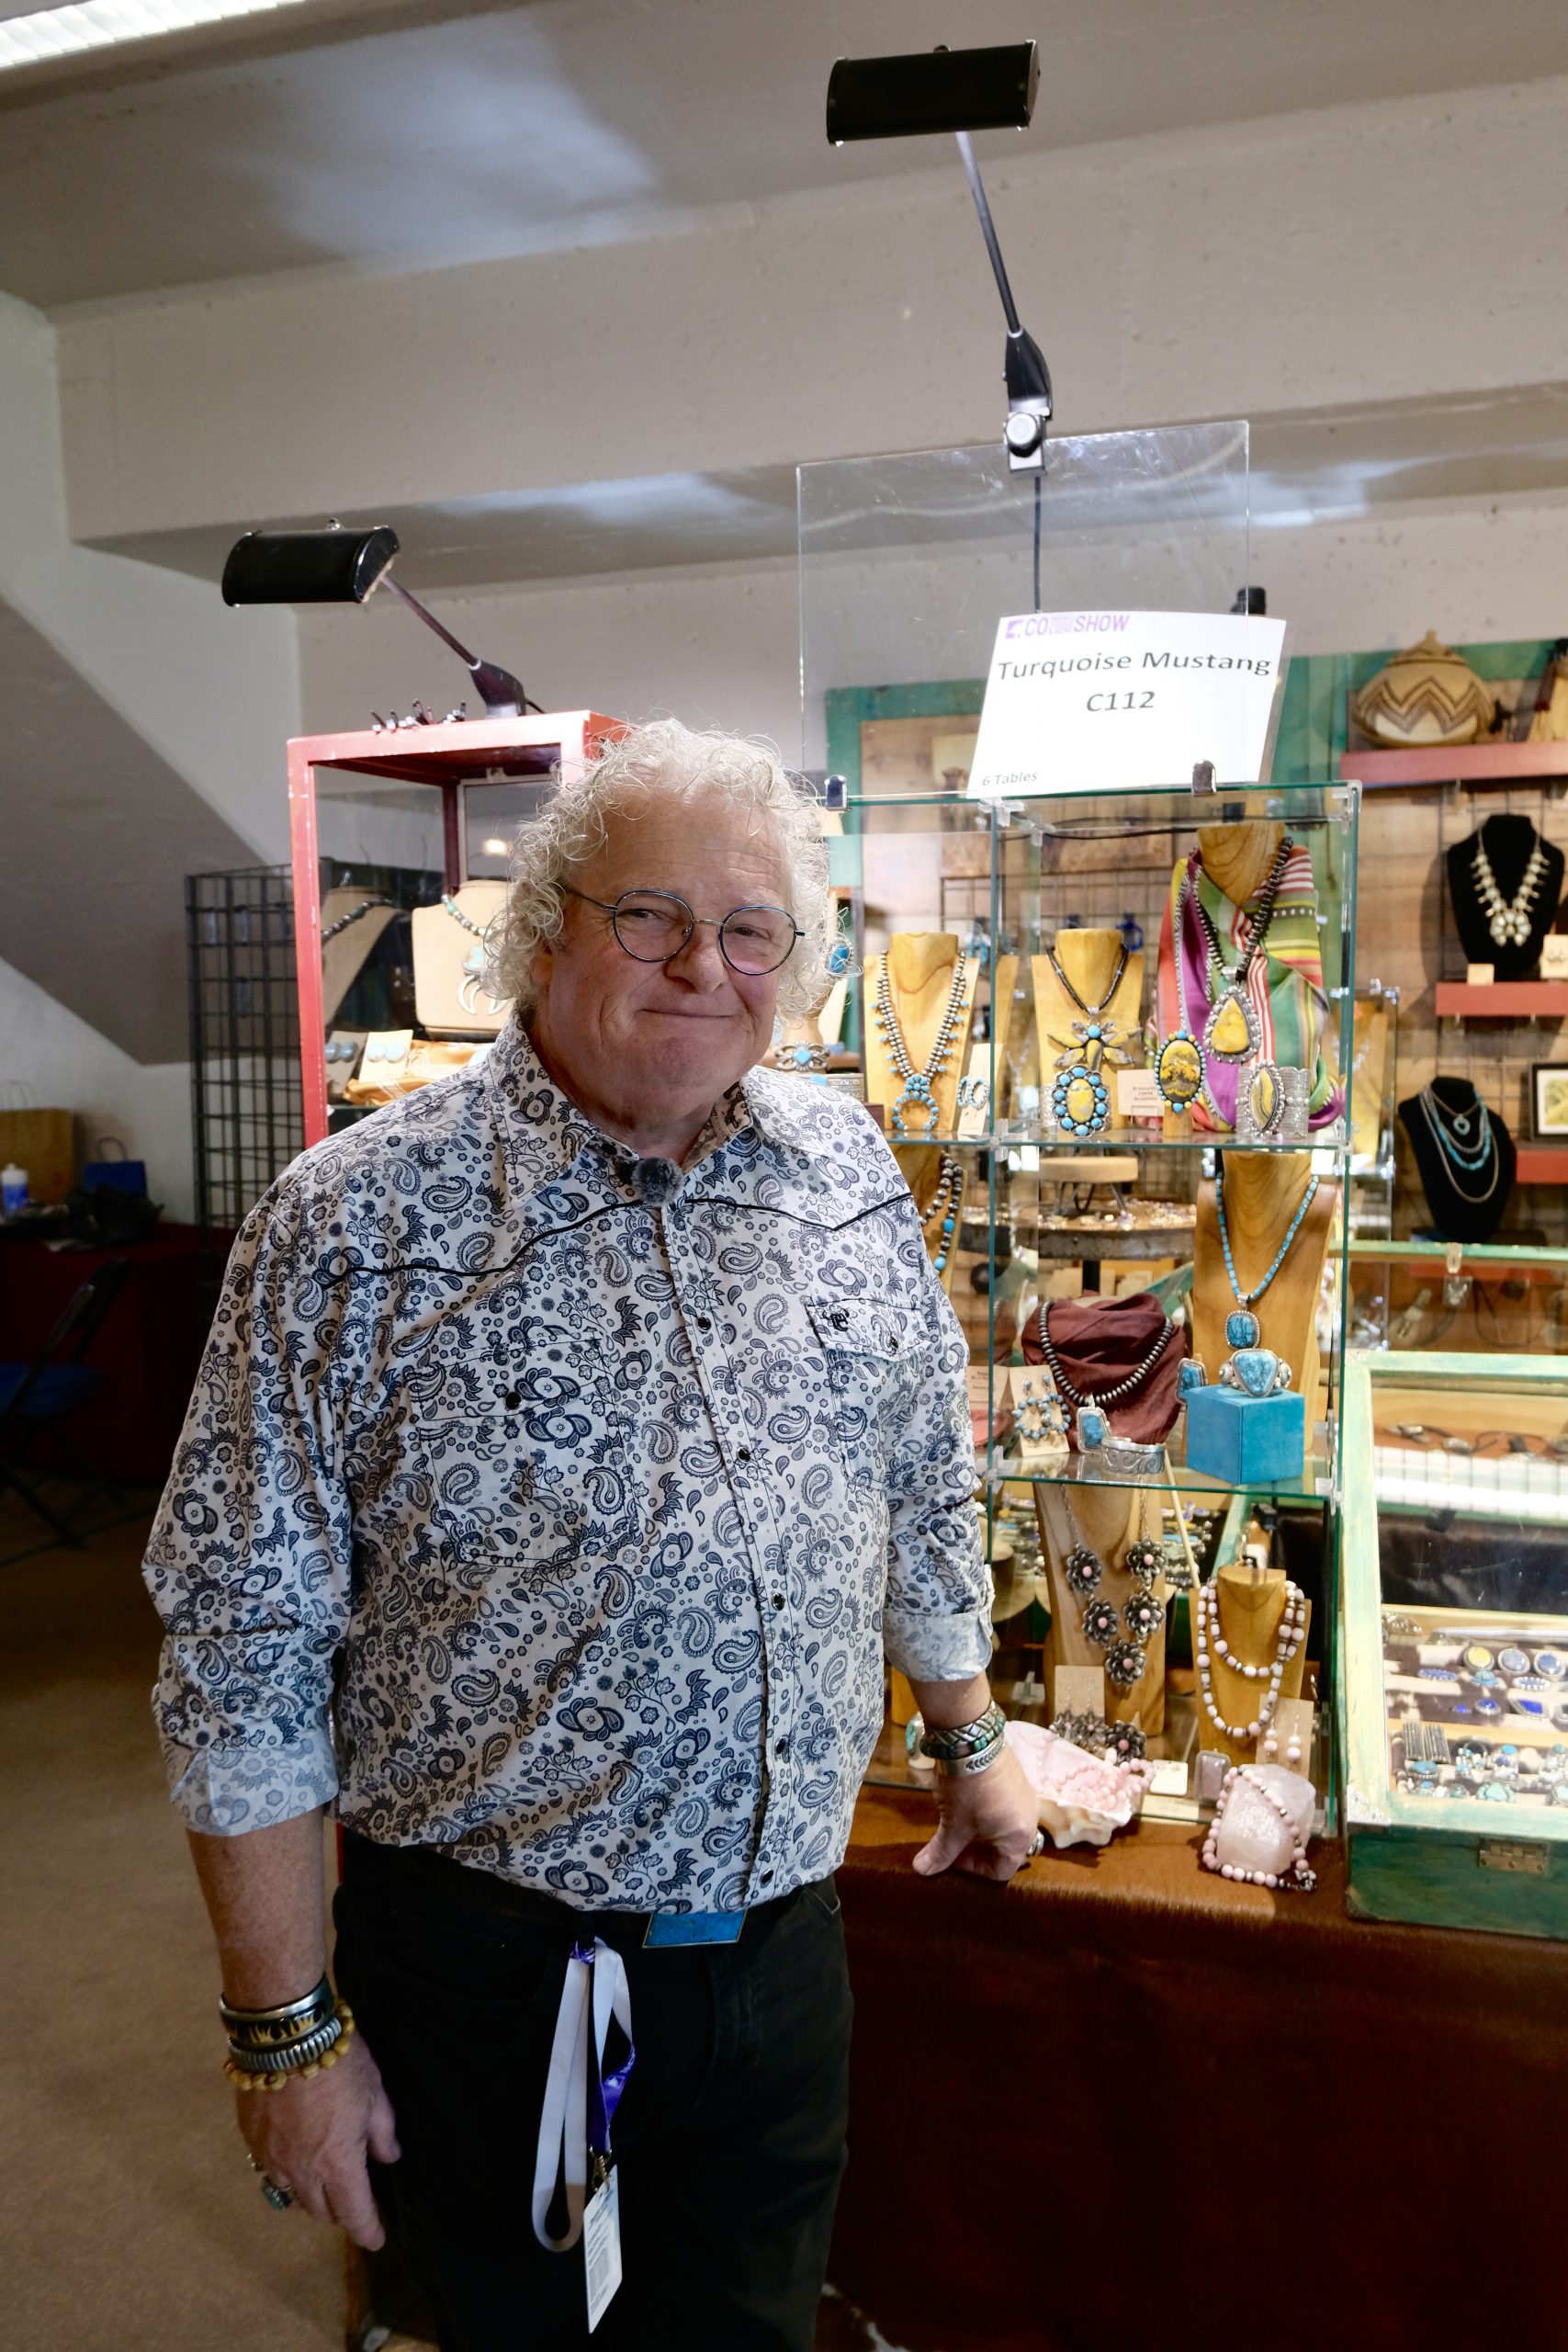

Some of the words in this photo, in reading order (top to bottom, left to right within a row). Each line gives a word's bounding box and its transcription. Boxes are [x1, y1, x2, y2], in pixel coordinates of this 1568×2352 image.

[998, 652, 1131, 680] Turquoise
[1142, 652, 1272, 676] Mustang
[1086, 691, 1156, 713] C112
[982, 775, 991, 786] 6
[995, 772, 1038, 786] Tables
